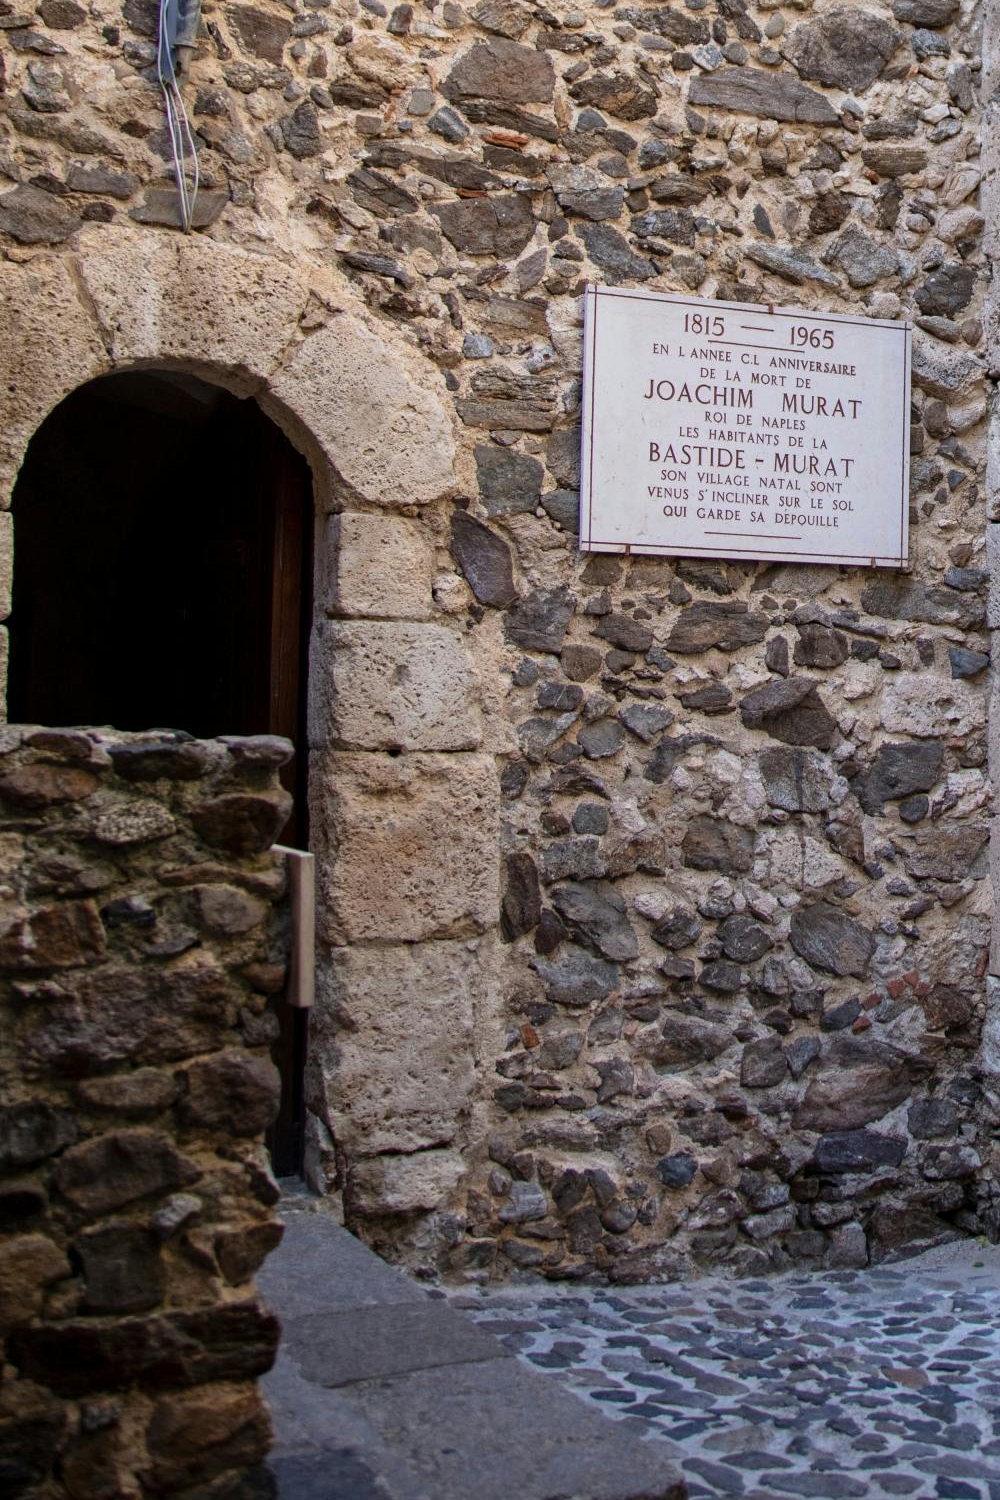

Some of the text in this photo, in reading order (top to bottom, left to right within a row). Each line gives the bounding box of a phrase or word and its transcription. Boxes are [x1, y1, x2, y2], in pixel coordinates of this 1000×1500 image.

[684, 314, 725, 336] 1815
[790, 326, 834, 349] 1965
[653, 343, 669, 355] EN
[769, 357, 856, 376] ANNIVERSAIRE
[701, 368, 811, 388] DE LA MORT DE
[644, 379, 863, 419] JOACHIM MURAT
[705, 411, 806, 430] ROI DE NAPLES
[680, 427, 827, 449] LES HABITANTS DE LA
[649, 442, 746, 469] BASTIDE
[774, 453, 855, 478] MURAT
[660, 470, 843, 493] SON VILLAGE NATAL SONT
[647, 486, 689, 500] VENUS
[779, 496, 801, 507] SUR
[811, 498, 823, 509] LE
[832, 500, 854, 511] SOL
[663, 505, 687, 517] QUI
[697, 508, 741, 521] GARDE
[750, 512, 765, 523] SA
